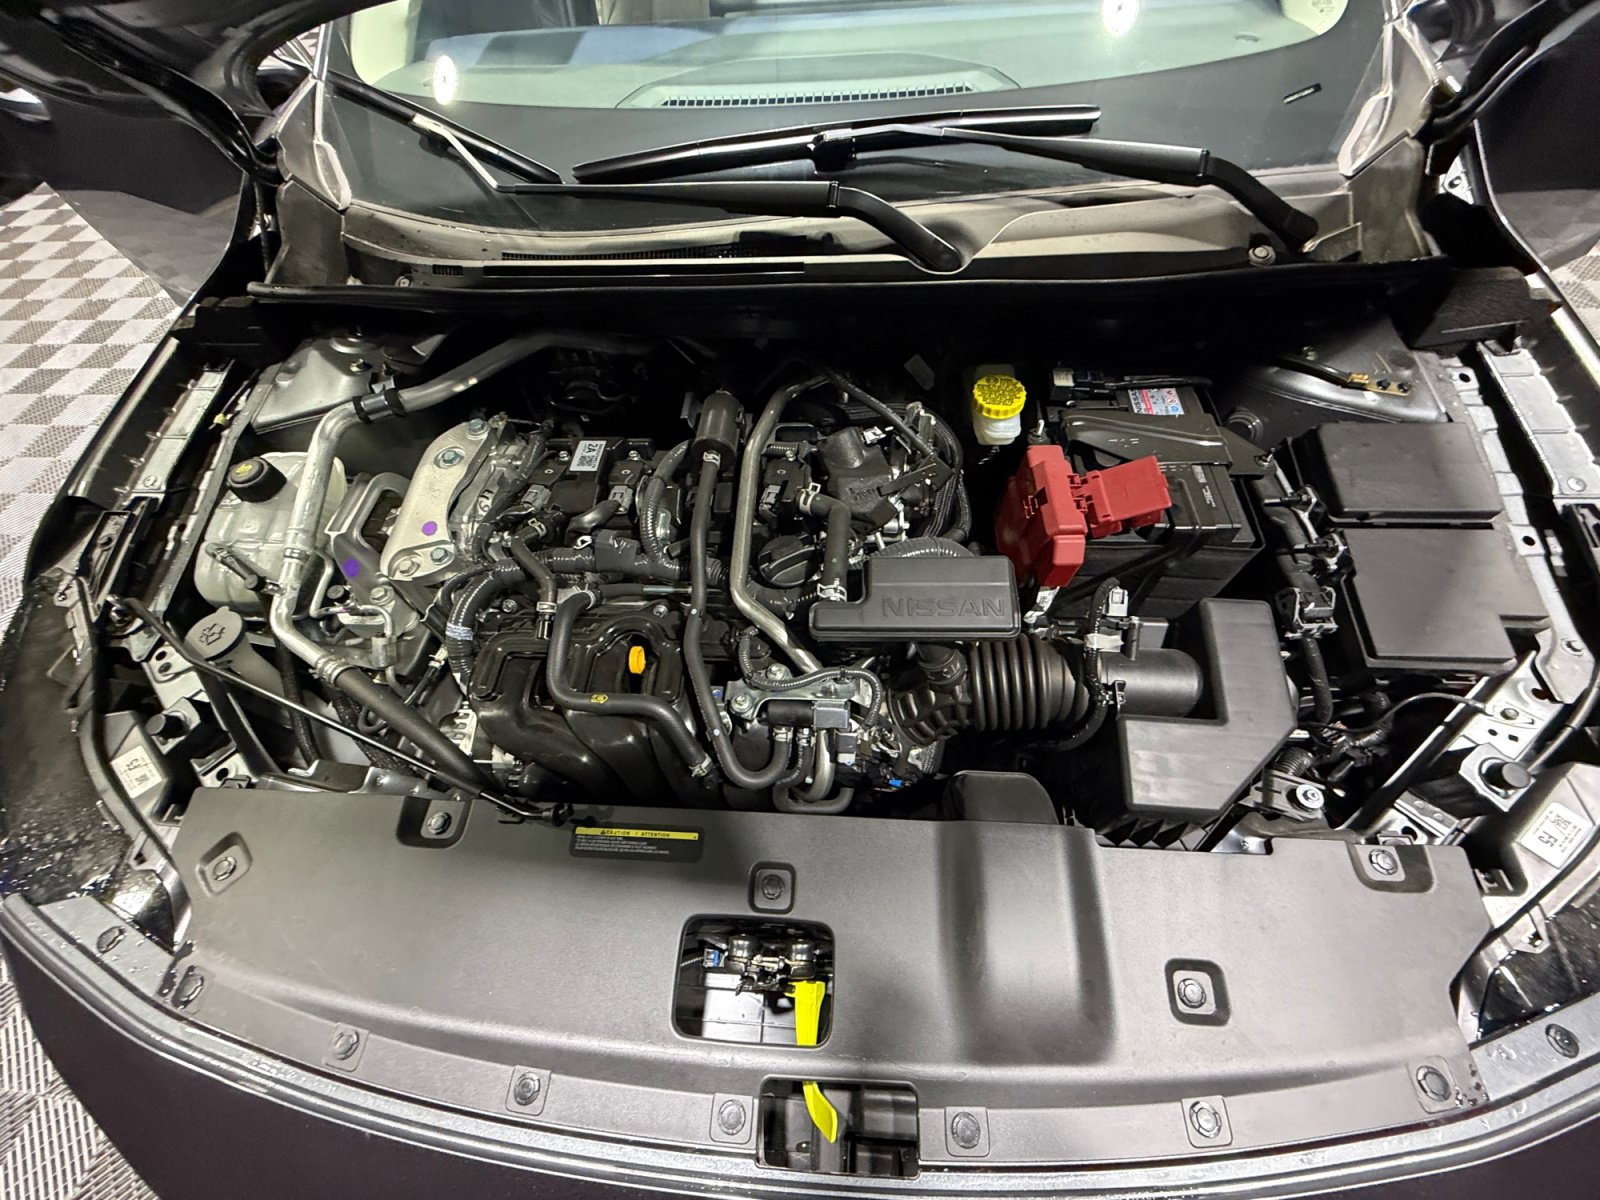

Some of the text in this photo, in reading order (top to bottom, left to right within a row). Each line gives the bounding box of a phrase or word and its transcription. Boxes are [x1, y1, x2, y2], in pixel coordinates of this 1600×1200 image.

[1131, 389, 1143, 414] NISSA
[585, 443, 599, 454] 2A
[881, 598, 1006, 617] NISSAN
[1537, 830, 1559, 848] F5
